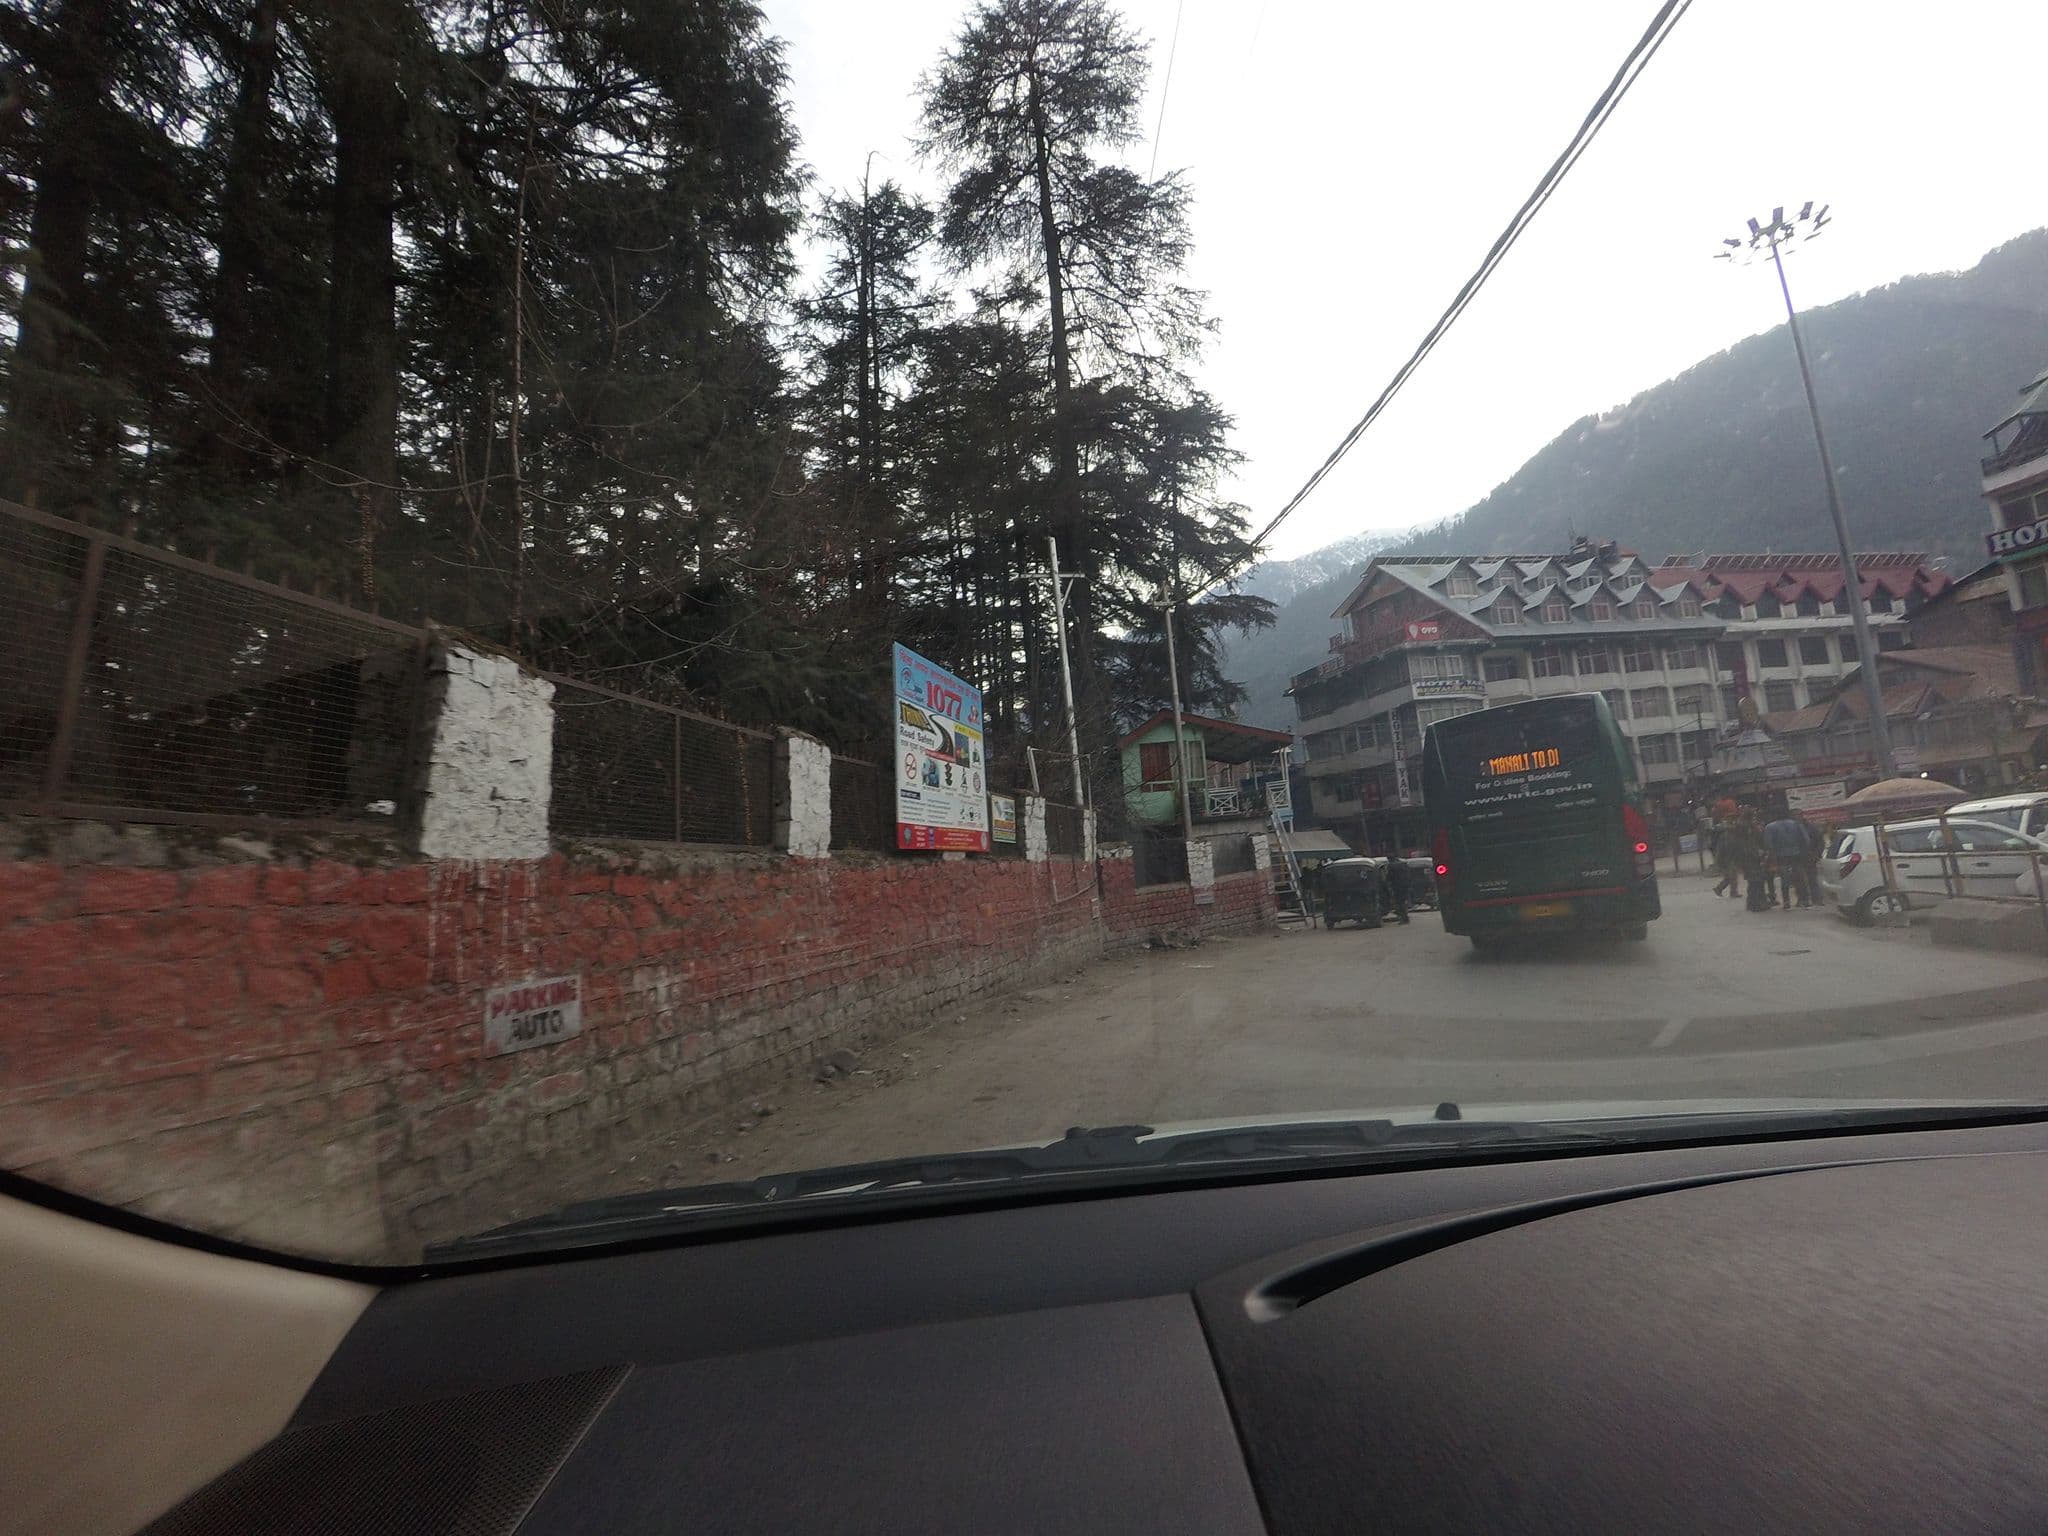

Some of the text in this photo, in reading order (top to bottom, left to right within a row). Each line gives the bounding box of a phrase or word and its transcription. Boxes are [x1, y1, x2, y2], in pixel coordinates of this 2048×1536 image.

[1421, 626, 1438, 634] OYO
[926, 681, 962, 721] 1077
[899, 727, 916, 742] Road
[917, 731, 935, 749] Safety
[1391, 706, 1402, 761] HOTEL
[1489, 754, 1530, 775] MANALI
[1532, 750, 1546, 769] TO
[1464, 783, 1593, 805] www.hrtc.gov.in
[1475, 781, 1491, 791] For
[509, 1009, 564, 1042] AUTO
